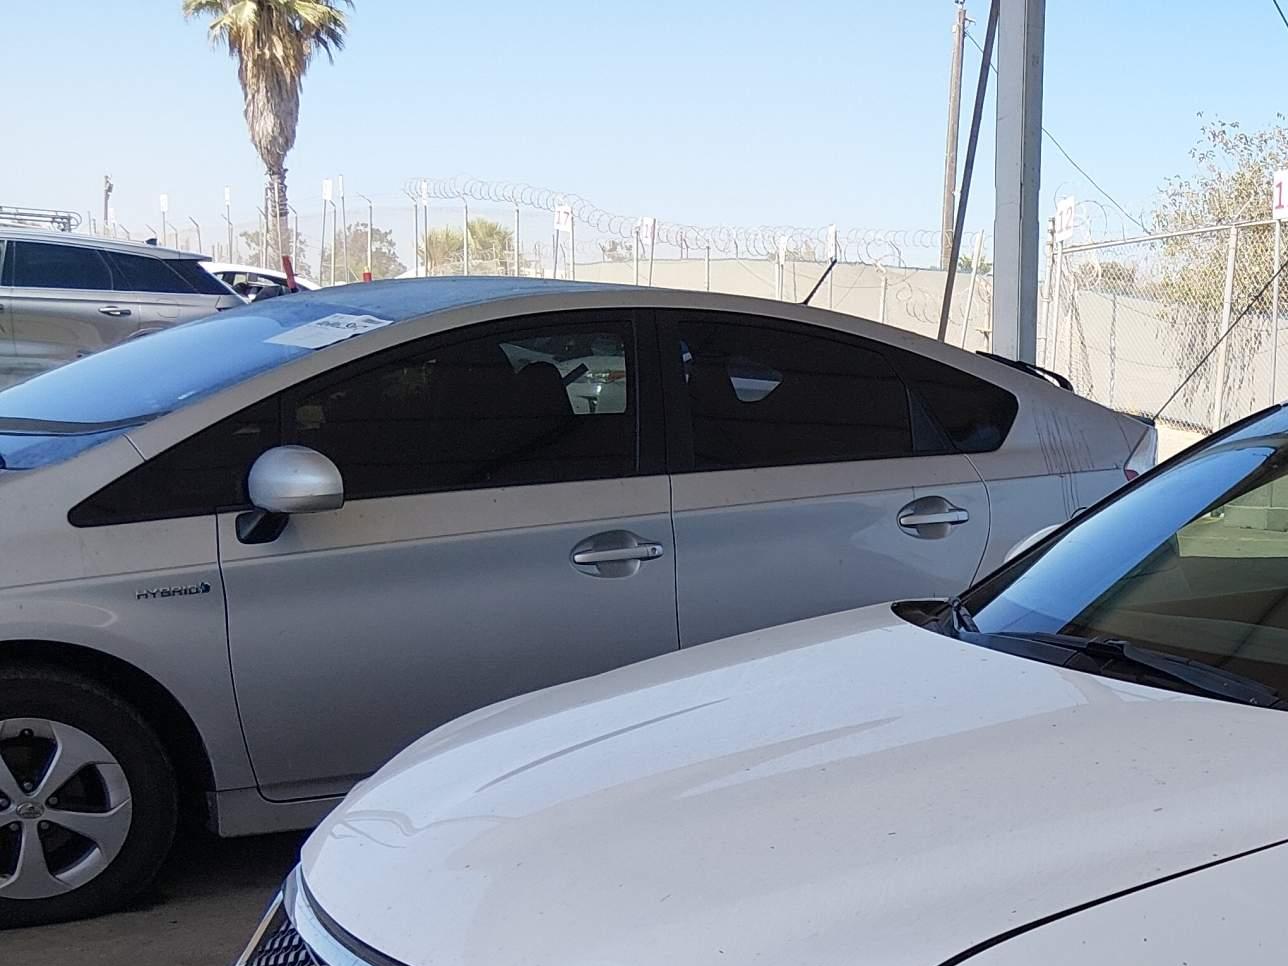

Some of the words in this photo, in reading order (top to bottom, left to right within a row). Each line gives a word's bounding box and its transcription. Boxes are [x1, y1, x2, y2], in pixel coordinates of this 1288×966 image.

[555, 210, 570, 225] 17
[1056, 205, 1075, 234] 12
[136, 583, 200, 600] HYBRID
